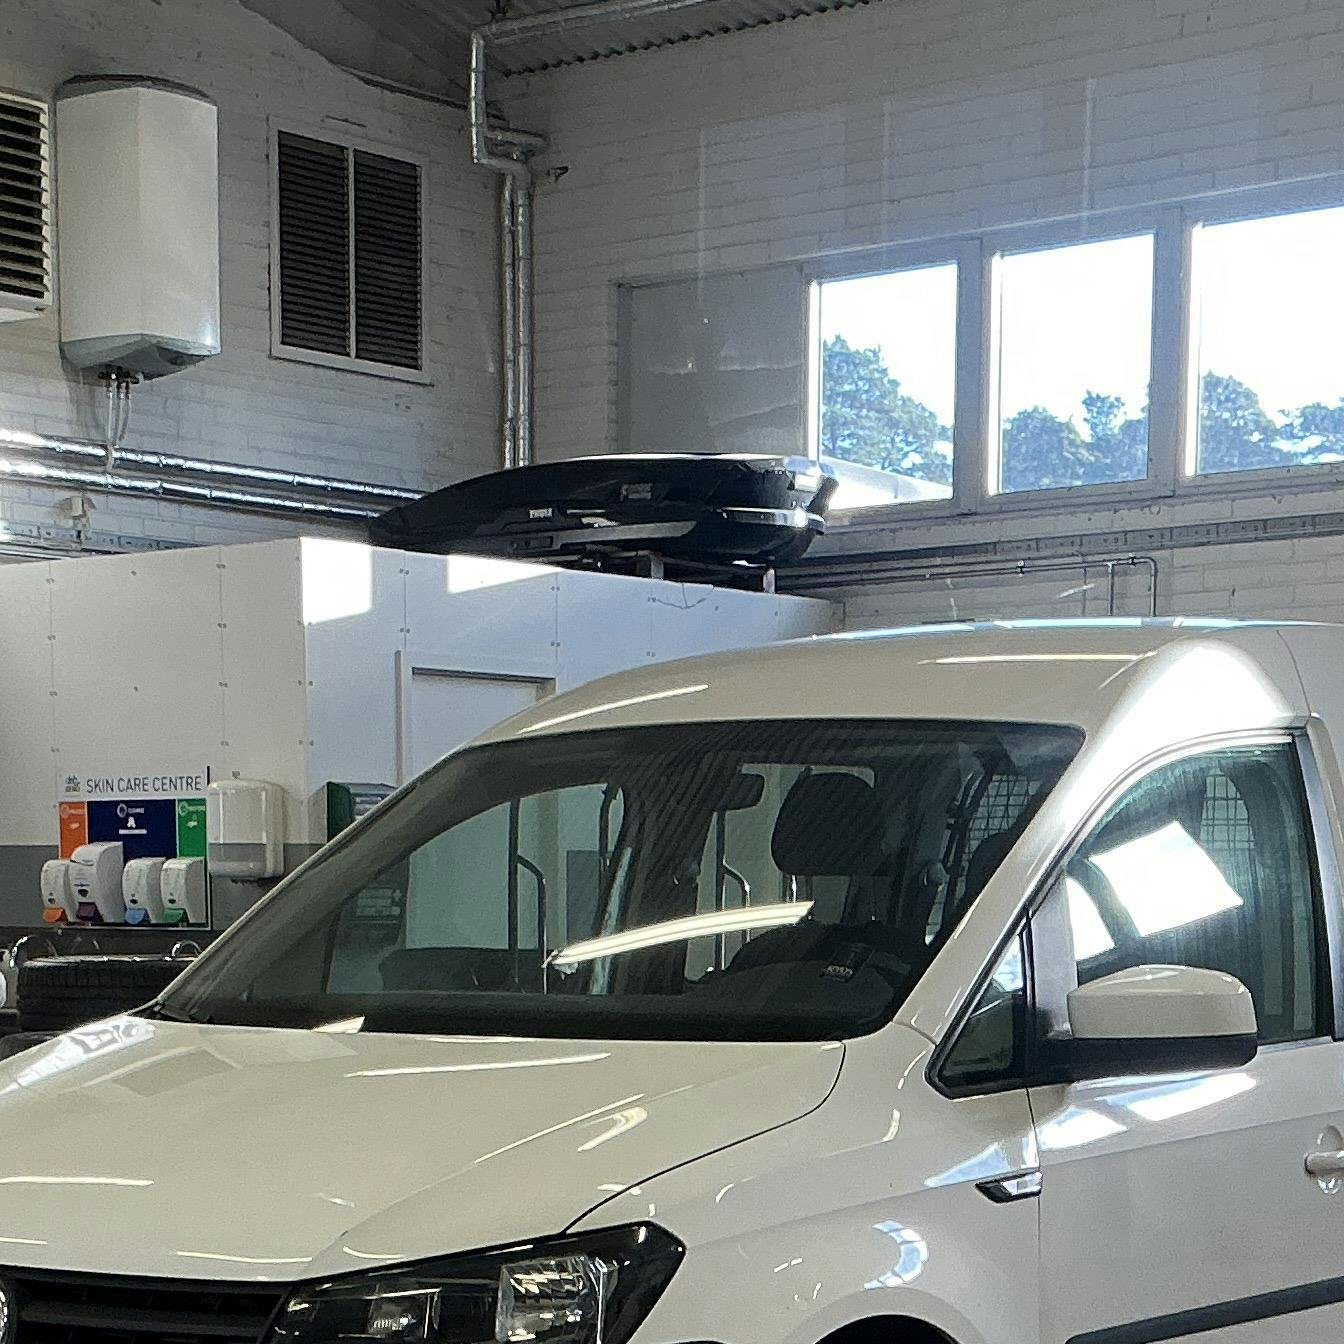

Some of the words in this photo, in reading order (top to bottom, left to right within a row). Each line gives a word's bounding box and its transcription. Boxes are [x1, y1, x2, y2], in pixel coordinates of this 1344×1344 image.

[86, 777, 114, 794] SKIN
[117, 777, 149, 793] CARE
[152, 775, 202, 792] CENTRE
